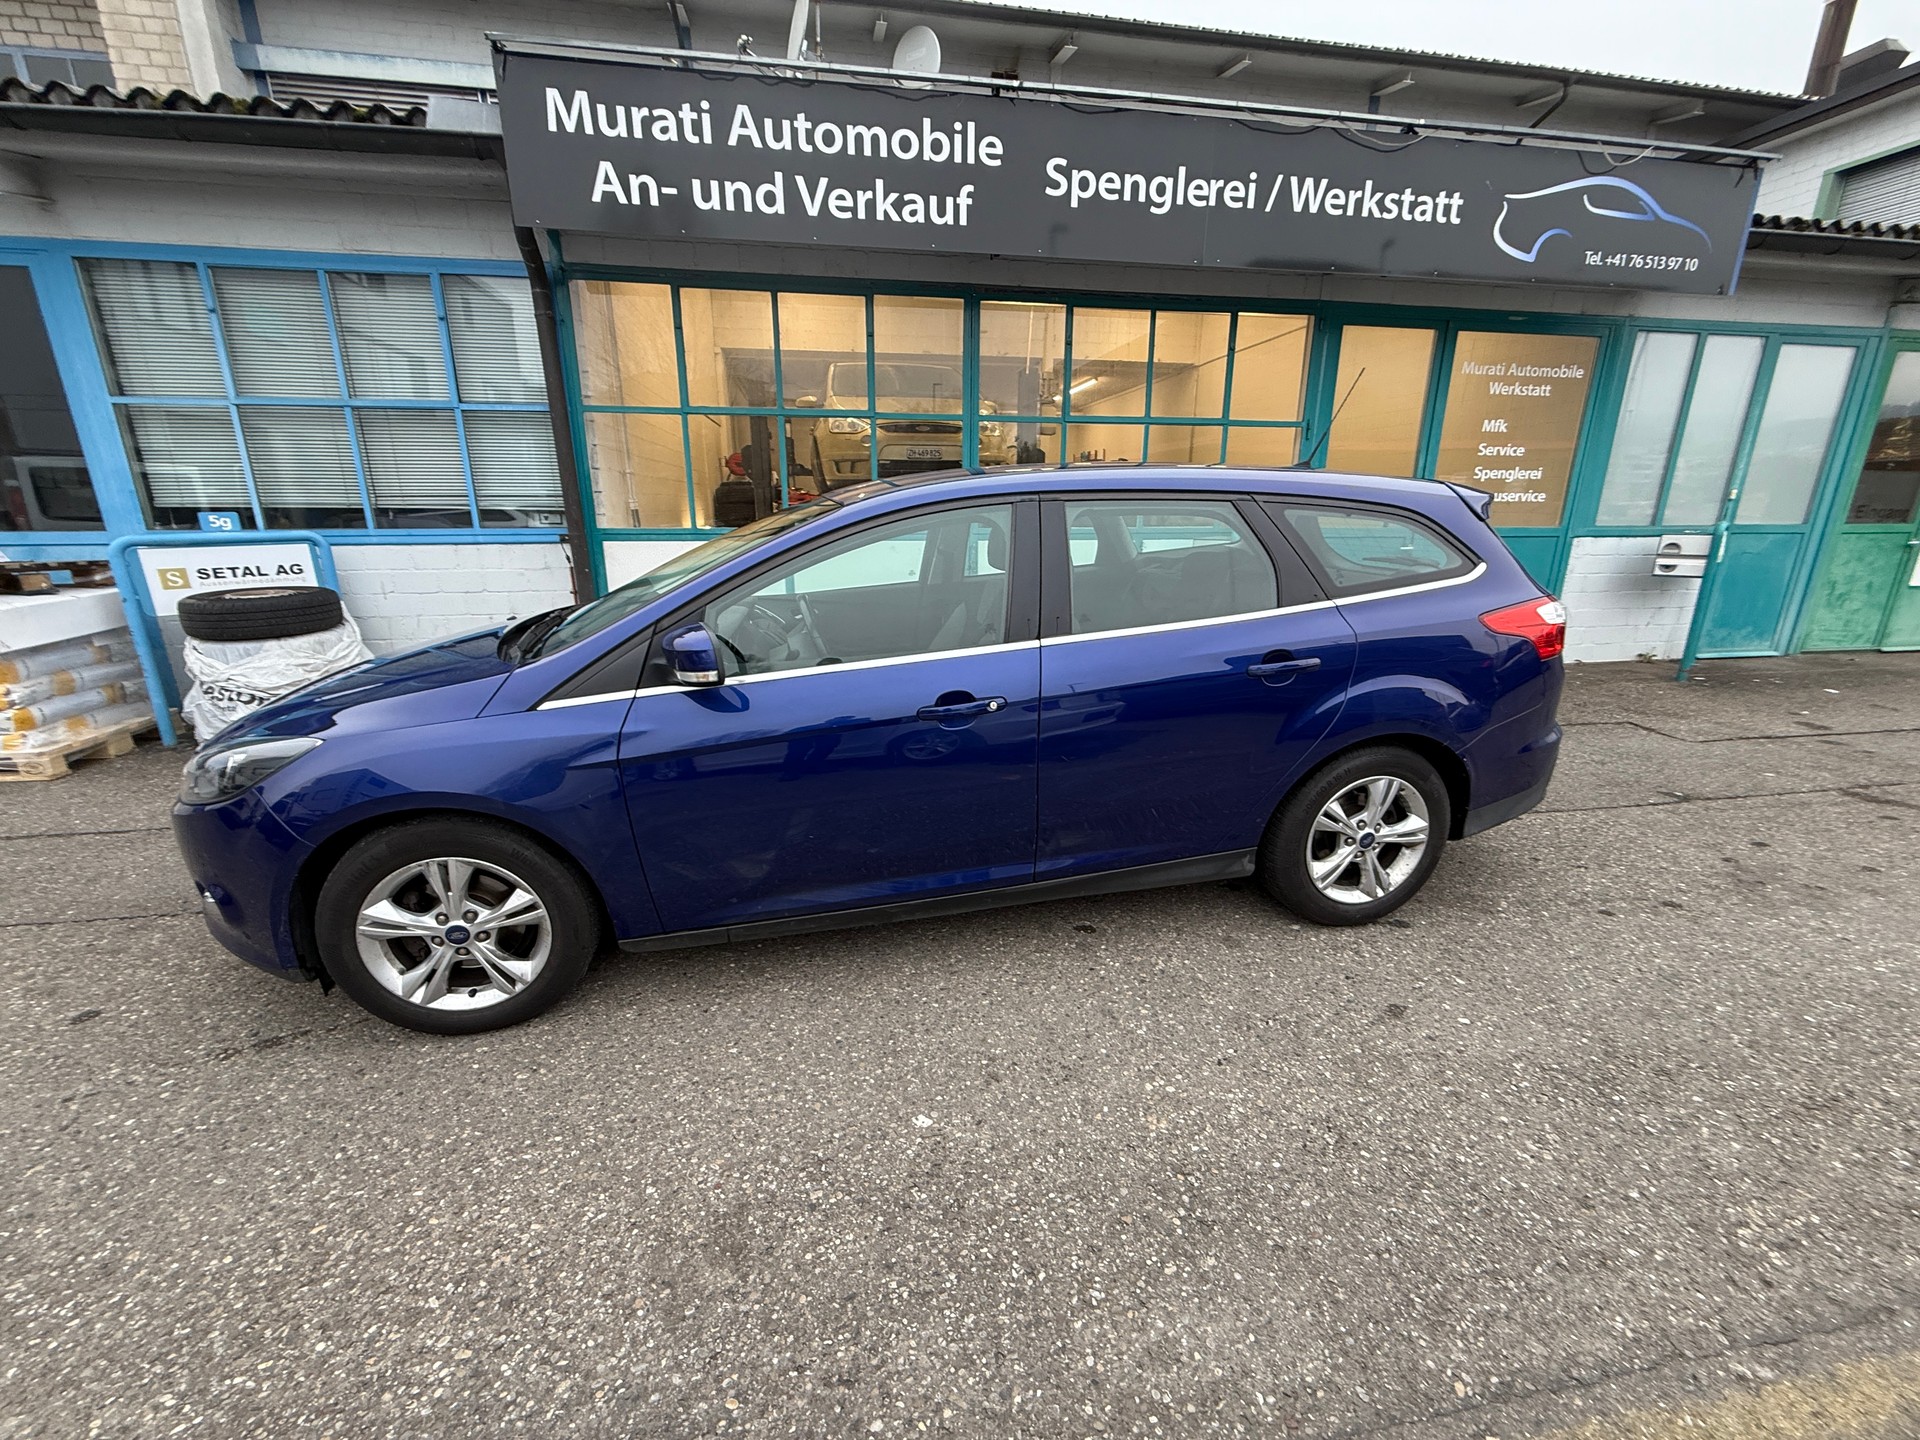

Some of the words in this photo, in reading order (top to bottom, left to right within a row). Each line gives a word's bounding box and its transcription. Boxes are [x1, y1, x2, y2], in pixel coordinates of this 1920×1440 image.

[546, 87, 712, 144] Murati
[728, 104, 1003, 166] Automobile
[591, 160, 678, 207] An-
[692, 171, 785, 215] und
[795, 175, 975, 226] Verkauf
[1045, 157, 1258, 215] Spenglerei
[1265, 174, 1283, 213] /
[1290, 175, 1464, 225] Werkstatt
[1604, 253, 1627, 267] +41
[1628, 254, 1644, 268] 76
[1644, 255, 1667, 270] 513
[1684, 258, 1699, 271] 10
[1461, 361, 1506, 376] Murati
[1507, 362, 1584, 379] Automobile
[1489, 381, 1551, 396] Werkstatt
[1481, 419, 1508, 432] Mfk
[1477, 443, 1525, 456] Service
[1473, 466, 1543, 482] Spenglerei
[1493, 490, 1546, 502] uservice
[208, 515, 232, 530] 5g
[166, 571, 184, 587] S
[196, 565, 270, 579] SETAL
[276, 563, 305, 576] AG
